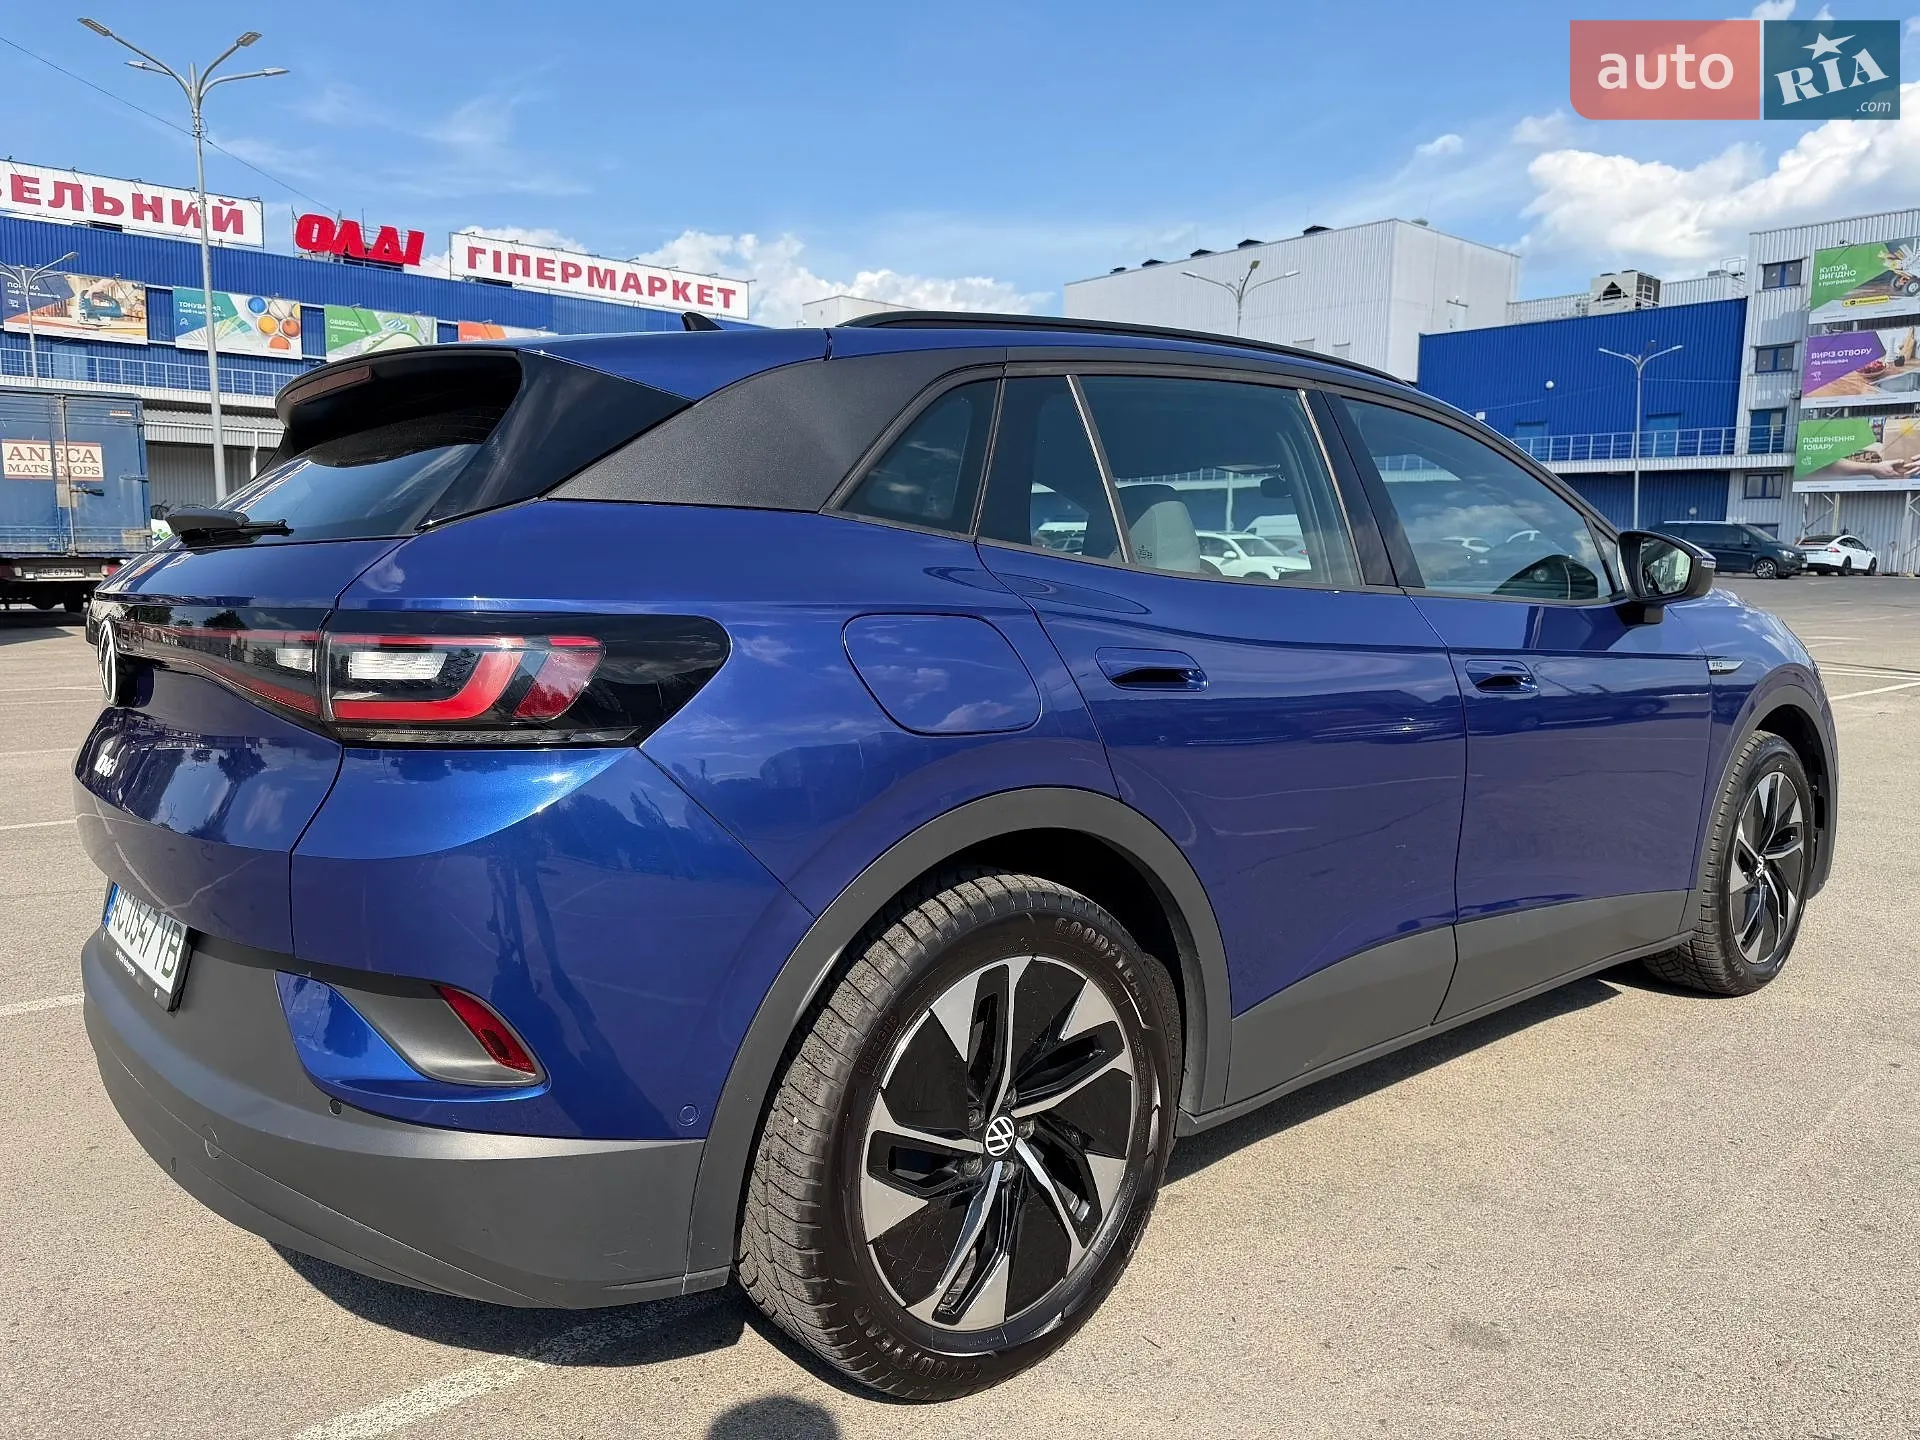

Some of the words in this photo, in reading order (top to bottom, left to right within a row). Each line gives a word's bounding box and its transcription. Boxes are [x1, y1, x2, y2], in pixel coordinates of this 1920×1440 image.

[0, 173, 244, 235] ЕЛЬНИЙ
[295, 214, 424, 266] ОЛДІ
[467, 245, 736, 309] ГІПЕРМАРКЕТ
[179, 301, 221, 311] ТОНУВАНЯ
[1811, 351, 1836, 359] ВИРІЗ
[1837, 348, 1872, 357] ОТВОРУ
[1803, 435, 1855, 443] ПОВЕРНЕННЯ
[1803, 443, 1834, 451] ТОВАРУ
[7, 446, 99, 463] ANECA
[8, 463, 49, 473] MATS
